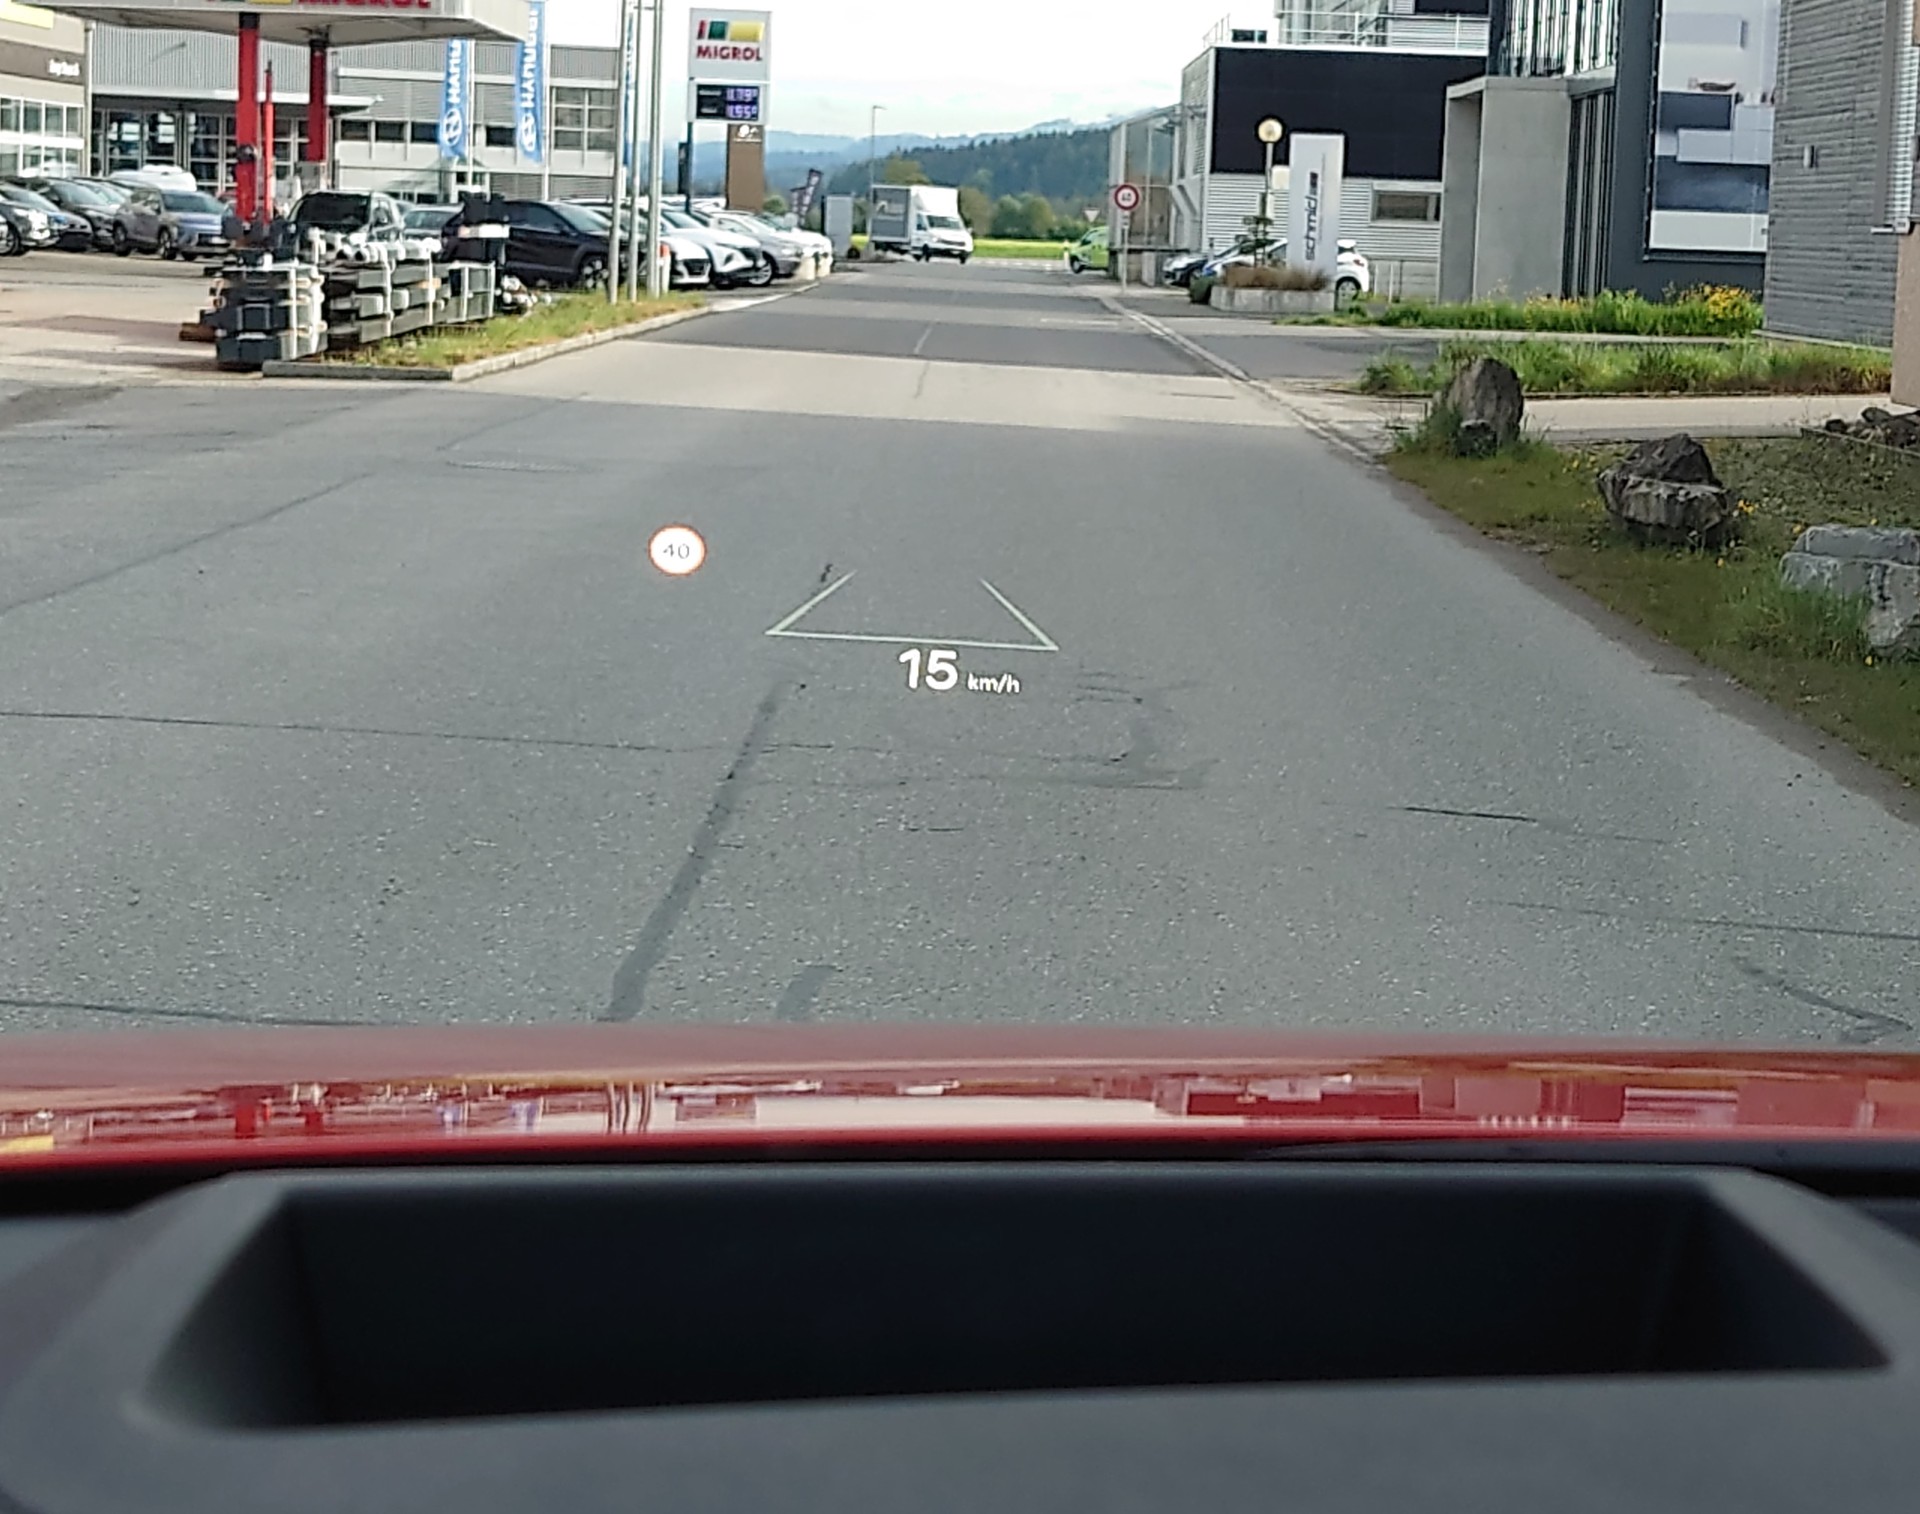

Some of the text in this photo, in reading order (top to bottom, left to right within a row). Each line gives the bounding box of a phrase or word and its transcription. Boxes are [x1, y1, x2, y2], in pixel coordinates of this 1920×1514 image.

[696, 45, 763, 62] MIGROL
[1304, 195, 1318, 261] schmid
[662, 543, 690, 560] 40
[899, 648, 1020, 694] 15 km/h
